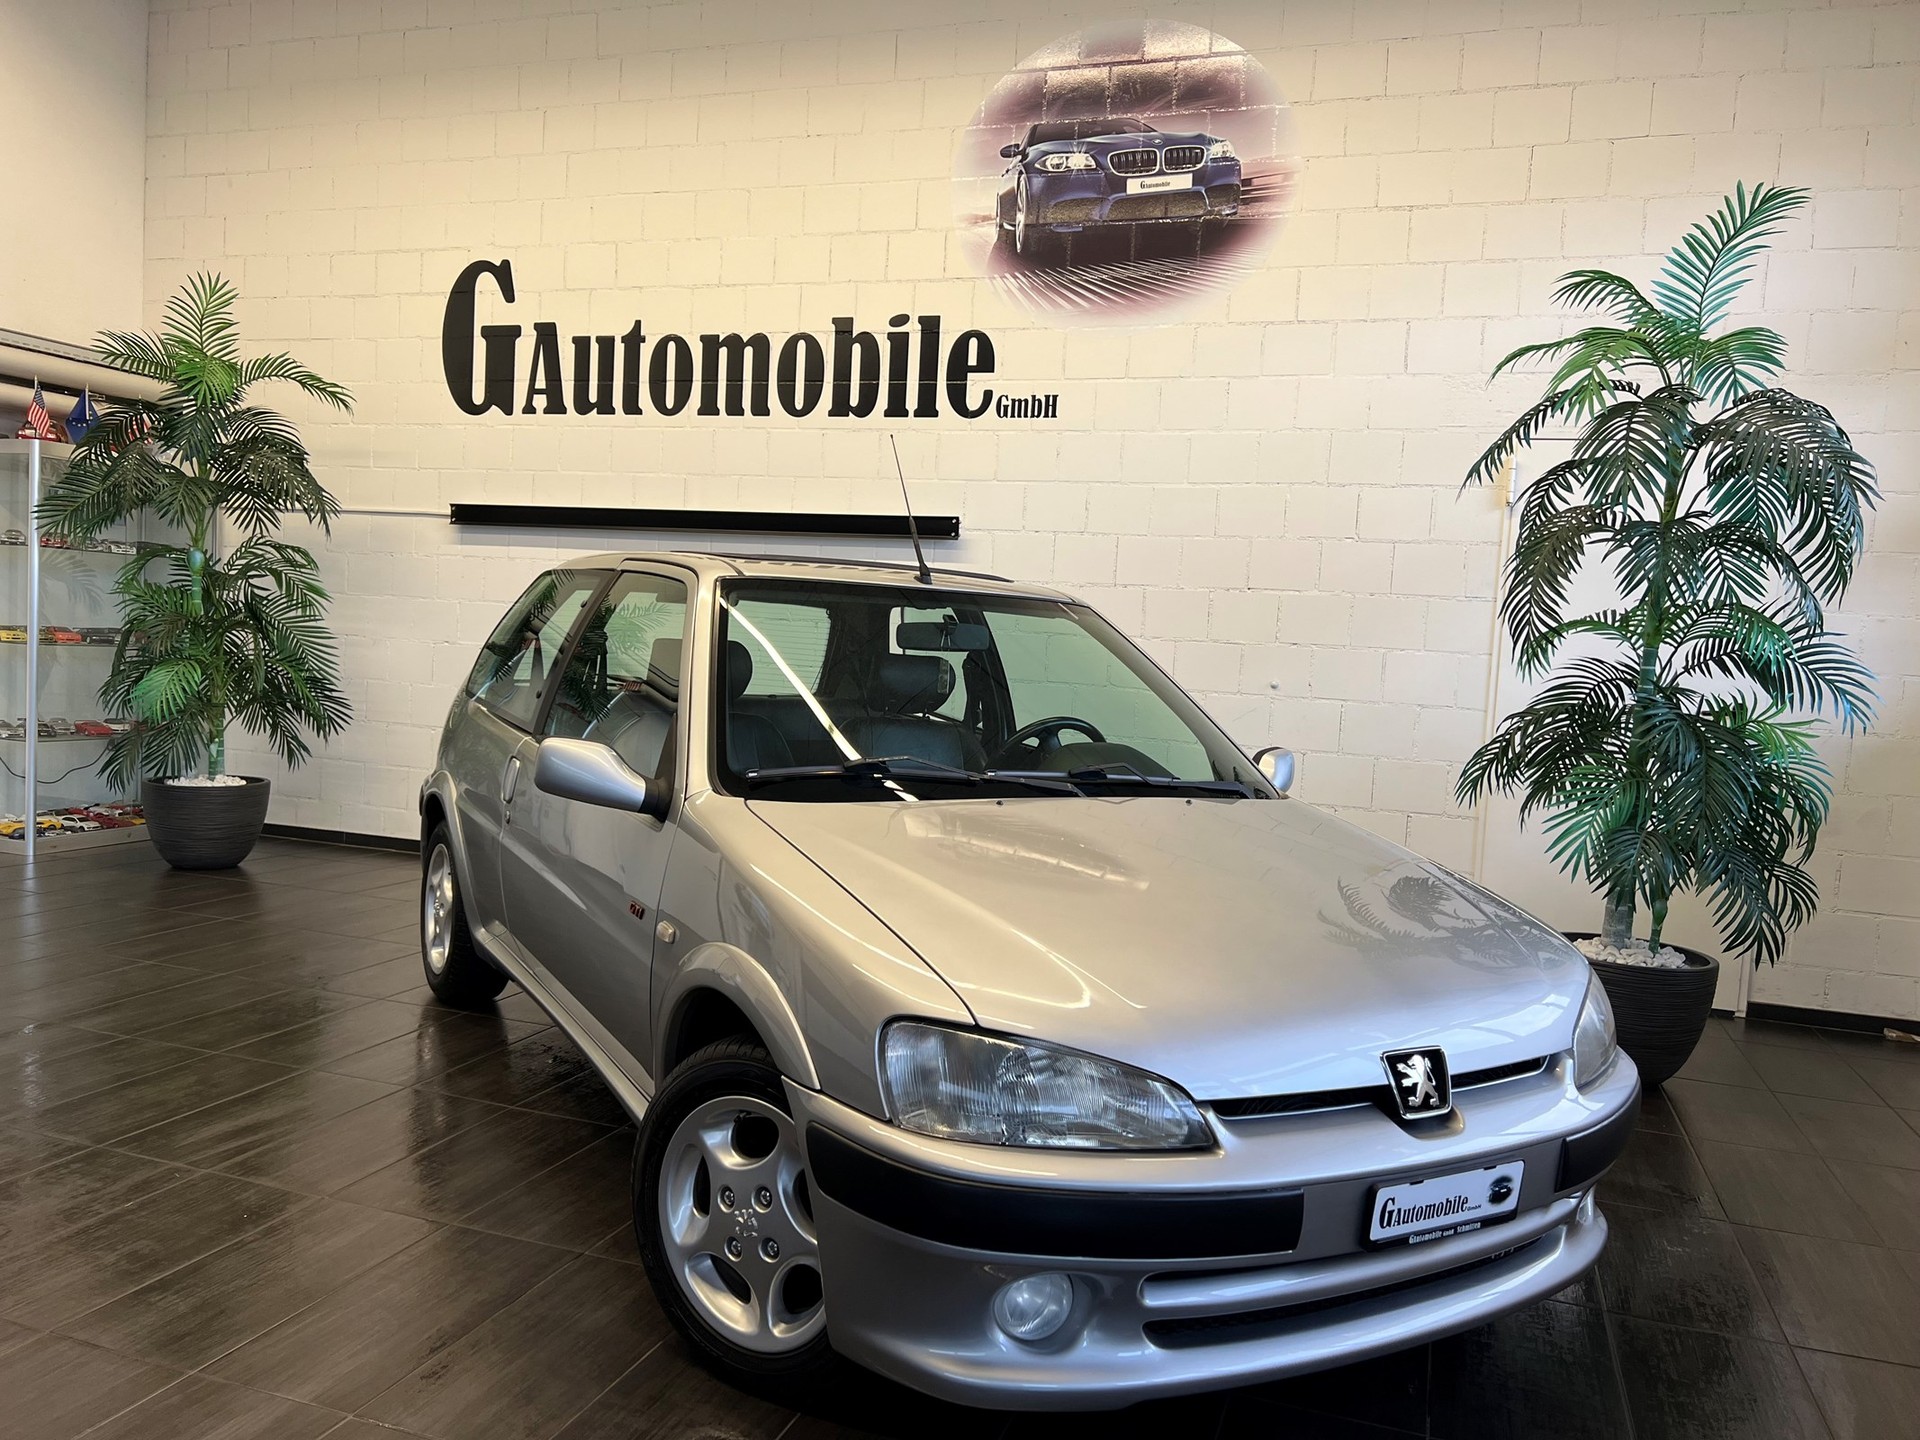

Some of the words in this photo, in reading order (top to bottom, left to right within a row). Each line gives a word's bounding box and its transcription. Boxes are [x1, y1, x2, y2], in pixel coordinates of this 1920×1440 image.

[442, 259, 995, 418] GAutomobile
[995, 394, 1058, 419] GmbH
[1379, 1195, 1468, 1229] GAutomobile
